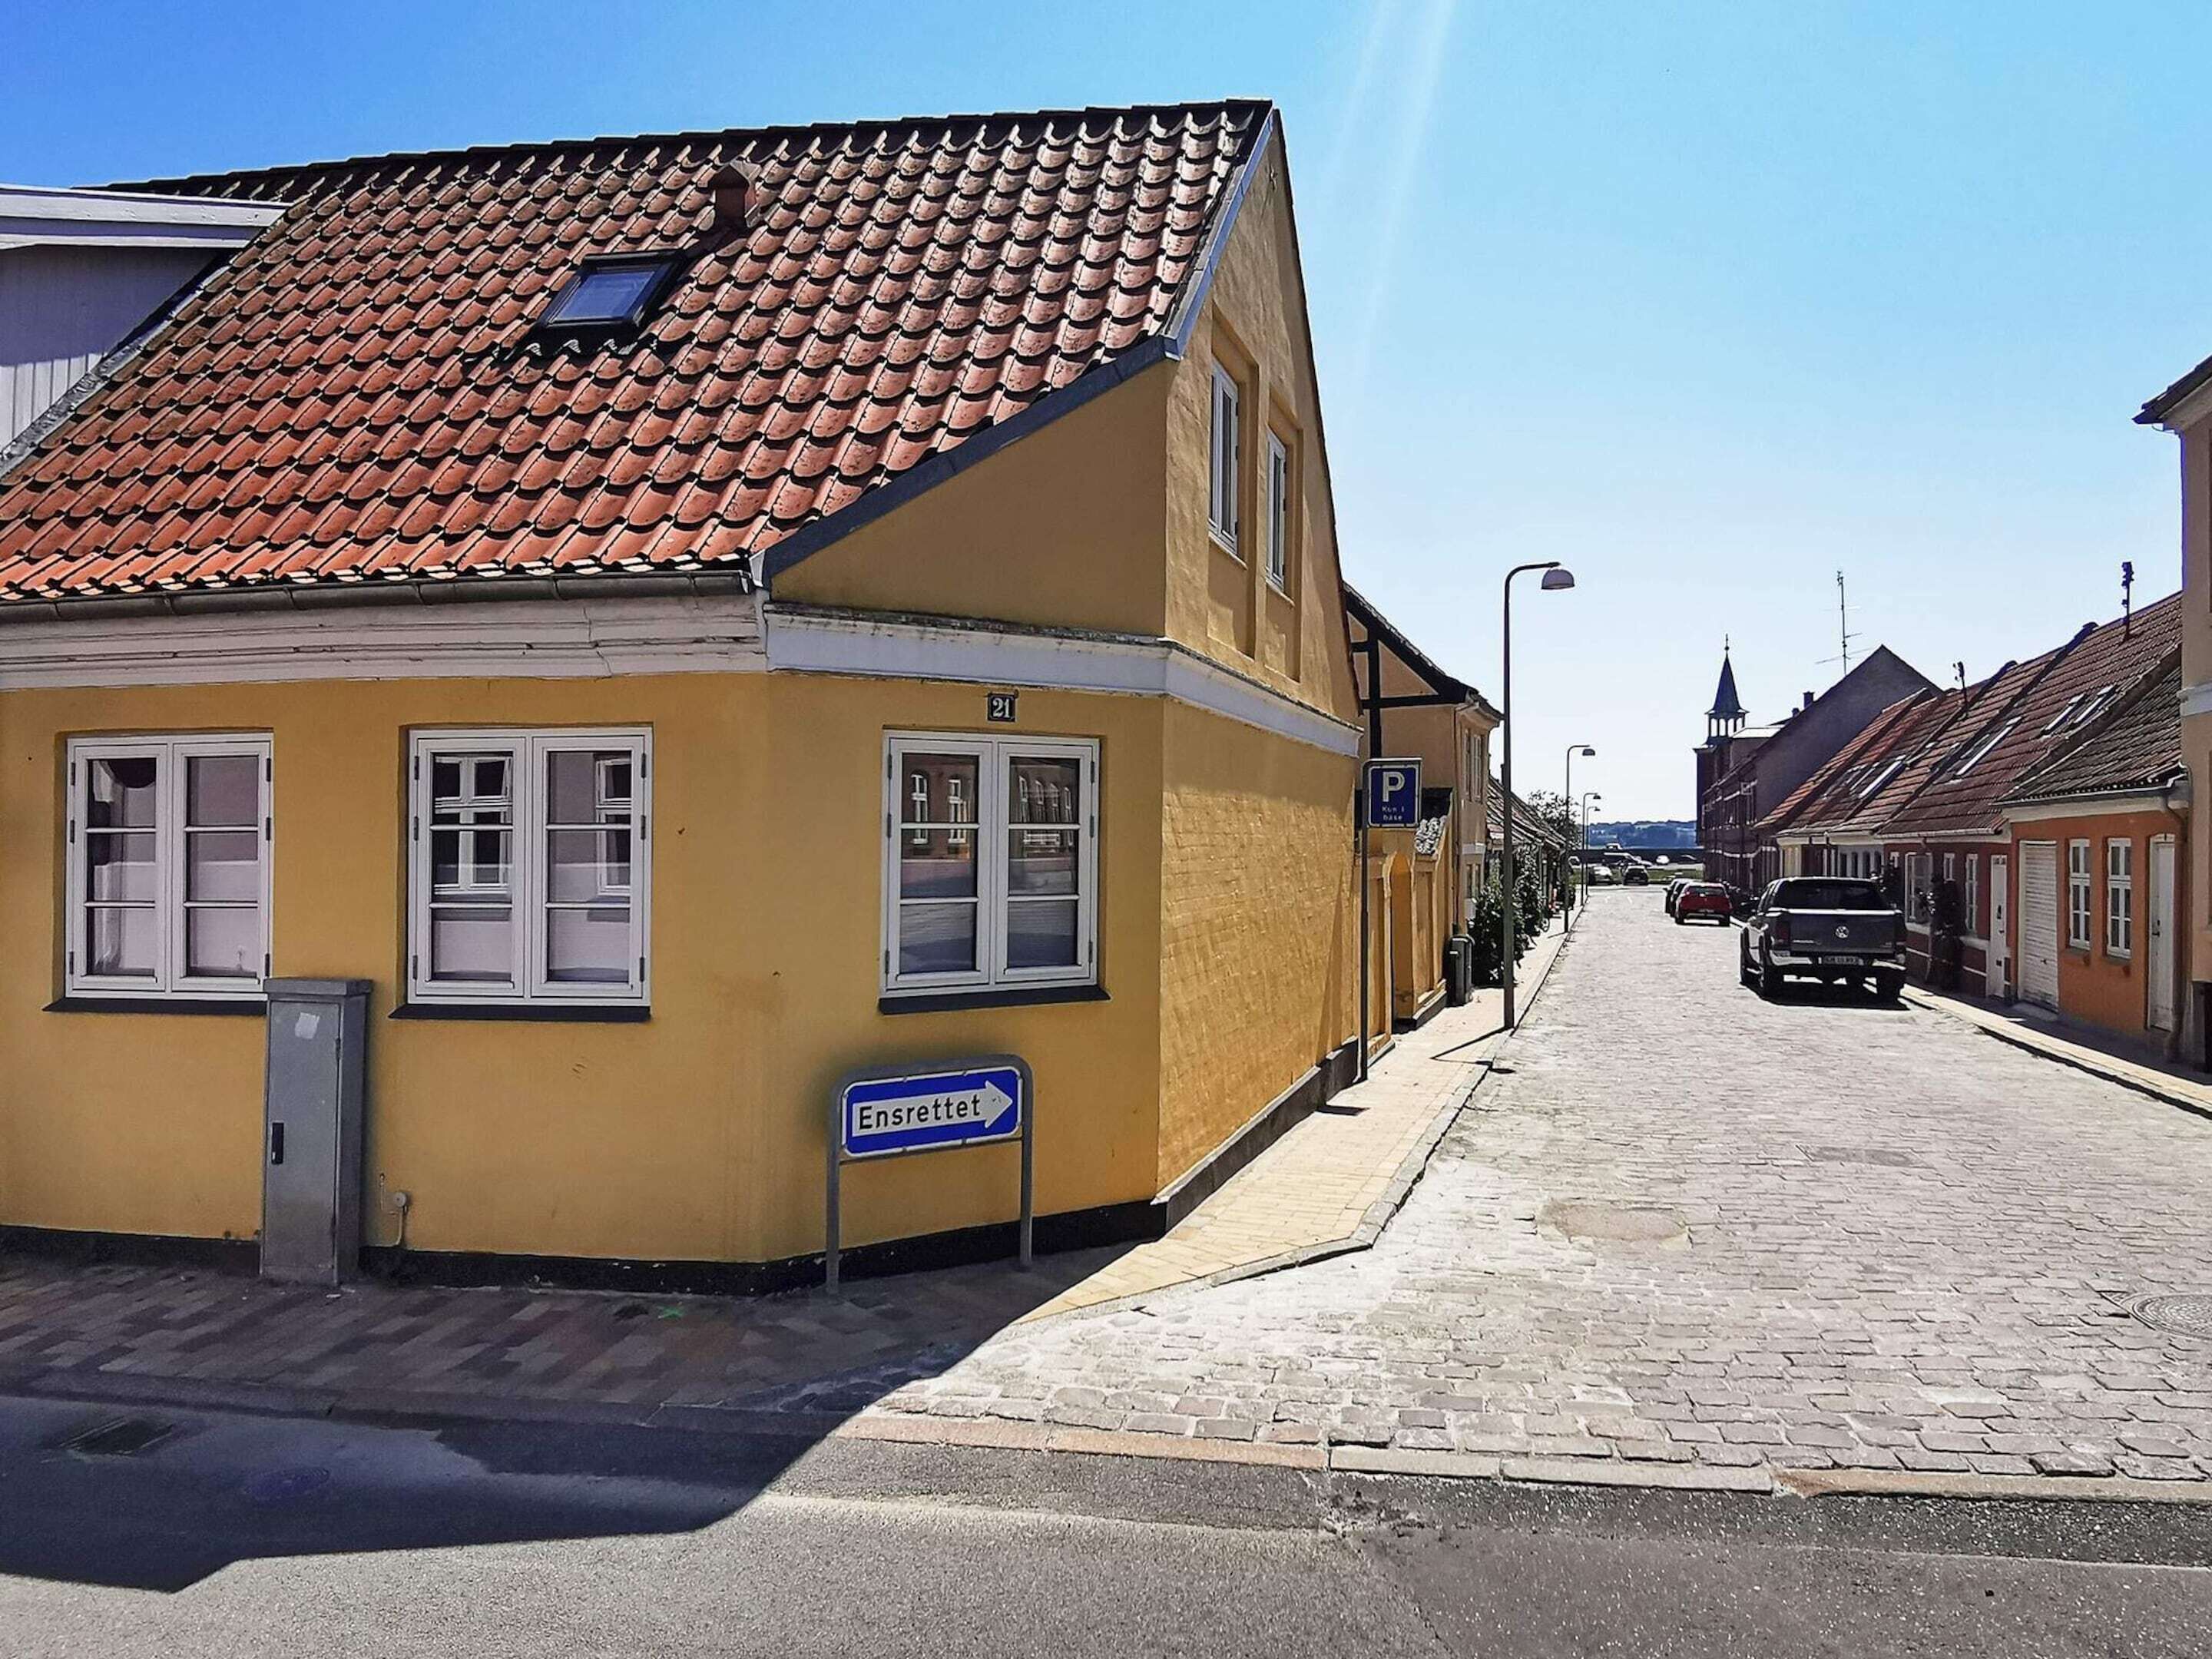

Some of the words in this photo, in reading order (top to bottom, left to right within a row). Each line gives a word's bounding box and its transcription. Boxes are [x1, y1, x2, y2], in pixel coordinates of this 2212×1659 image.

[993, 698, 1009, 717] 21
[1382, 771, 1406, 802] P
[859, 1094, 980, 1130] Ensrettet
